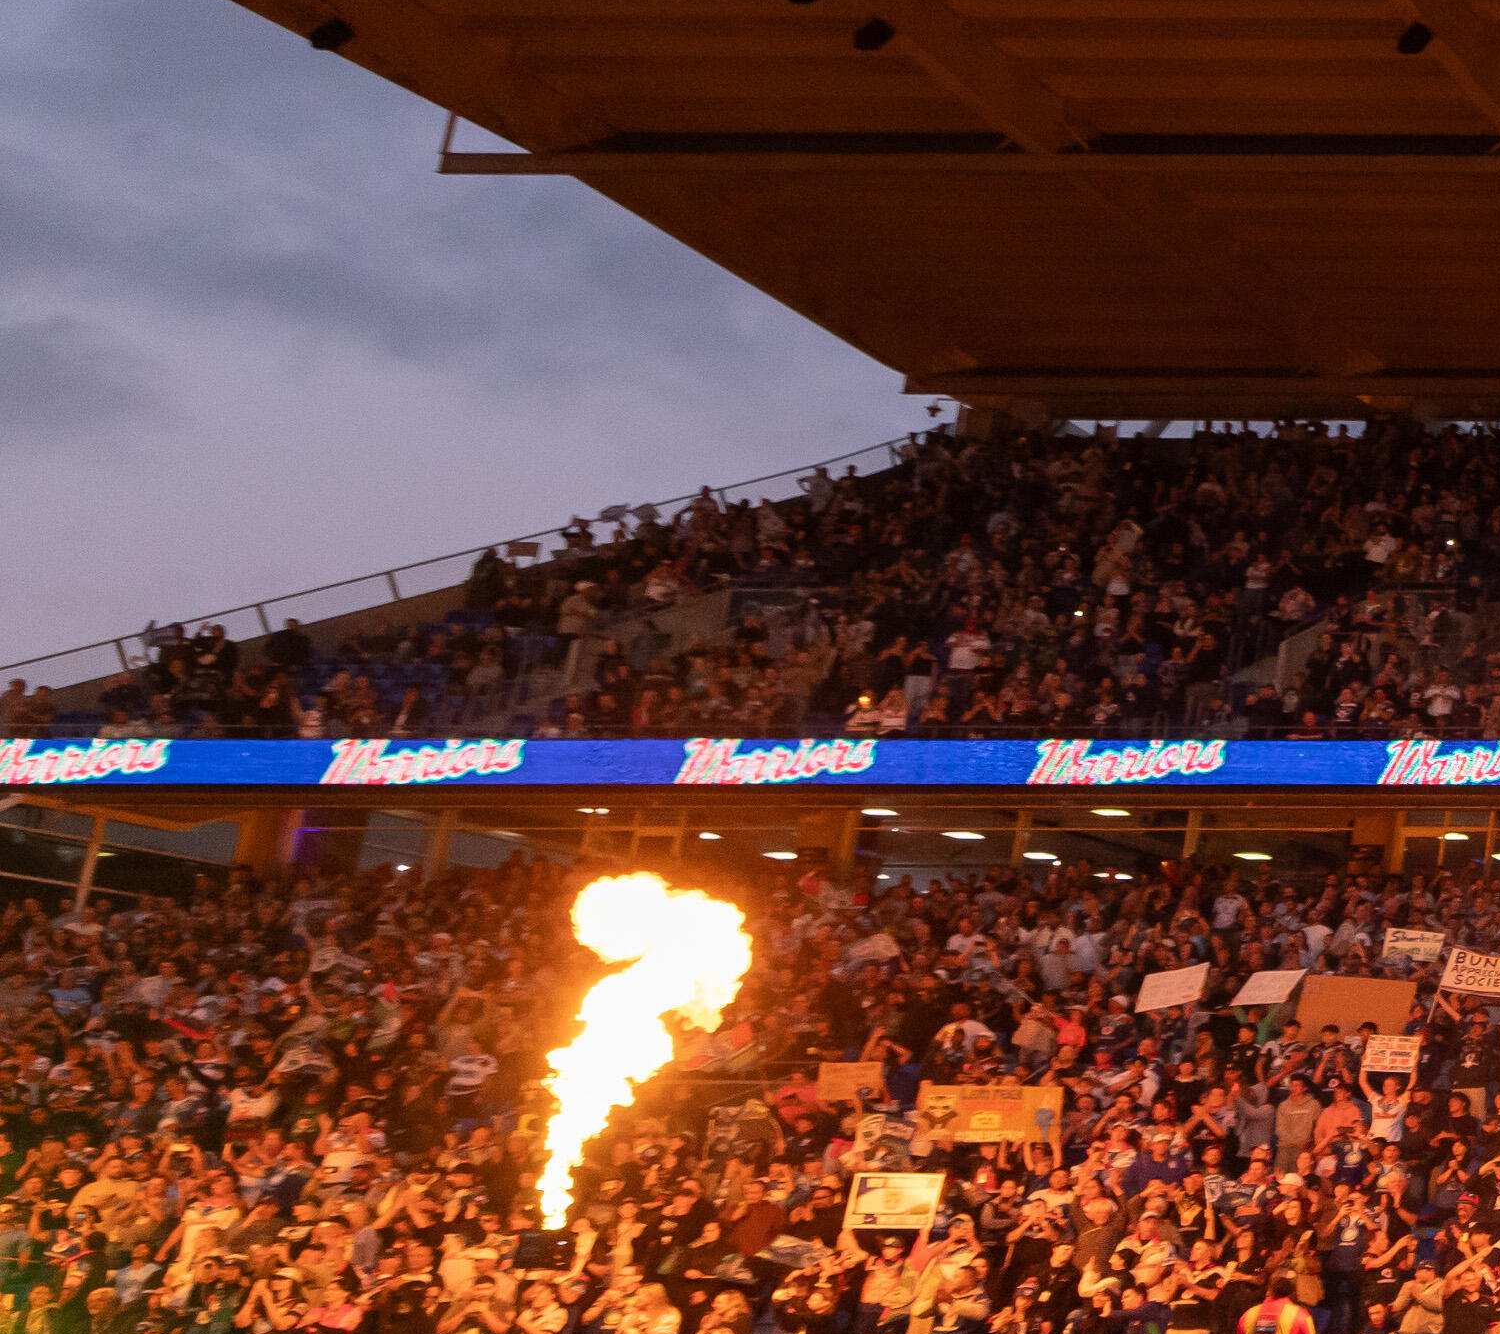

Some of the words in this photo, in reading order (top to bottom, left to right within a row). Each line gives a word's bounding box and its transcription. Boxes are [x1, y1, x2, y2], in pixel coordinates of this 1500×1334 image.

[320, 739, 526, 784] Warriors
[673, 738, 878, 785] Warriors
[1026, 738, 1252, 785] Warriors
